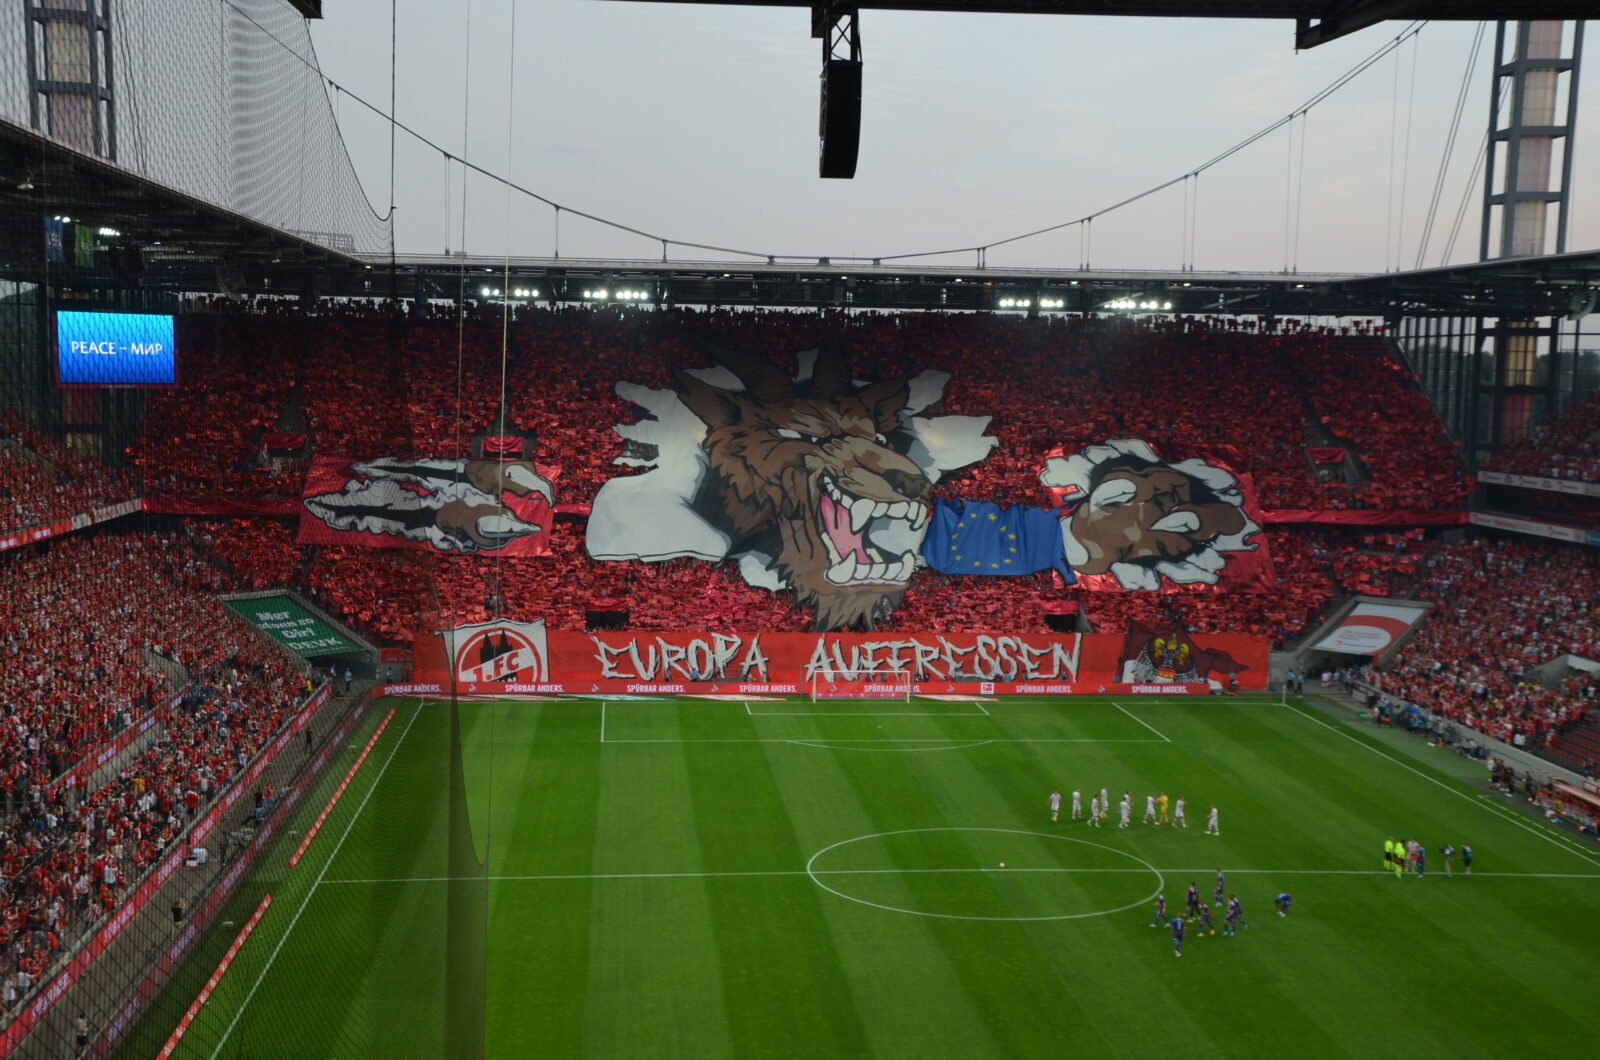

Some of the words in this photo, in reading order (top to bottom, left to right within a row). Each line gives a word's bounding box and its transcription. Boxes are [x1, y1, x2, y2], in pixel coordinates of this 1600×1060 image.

[71, 341, 117, 354] PEACE
[131, 343, 163, 355] МИР
[590, 632, 769, 682] EUROPA
[804, 632, 1082, 683] AUFFRESSEN
[505, 683, 536, 693] SPÜRBAR
[626, 683, 657, 693] SPÜRBAR
[658, 684, 686, 693] ANDERS.
[739, 683, 768, 693] SPÜRBAR
[770, 684, 798, 693] ANDERS.
[1015, 683, 1044, 693] SPÜRBAR
[1131, 684, 1161, 693] SPÜRBAR
